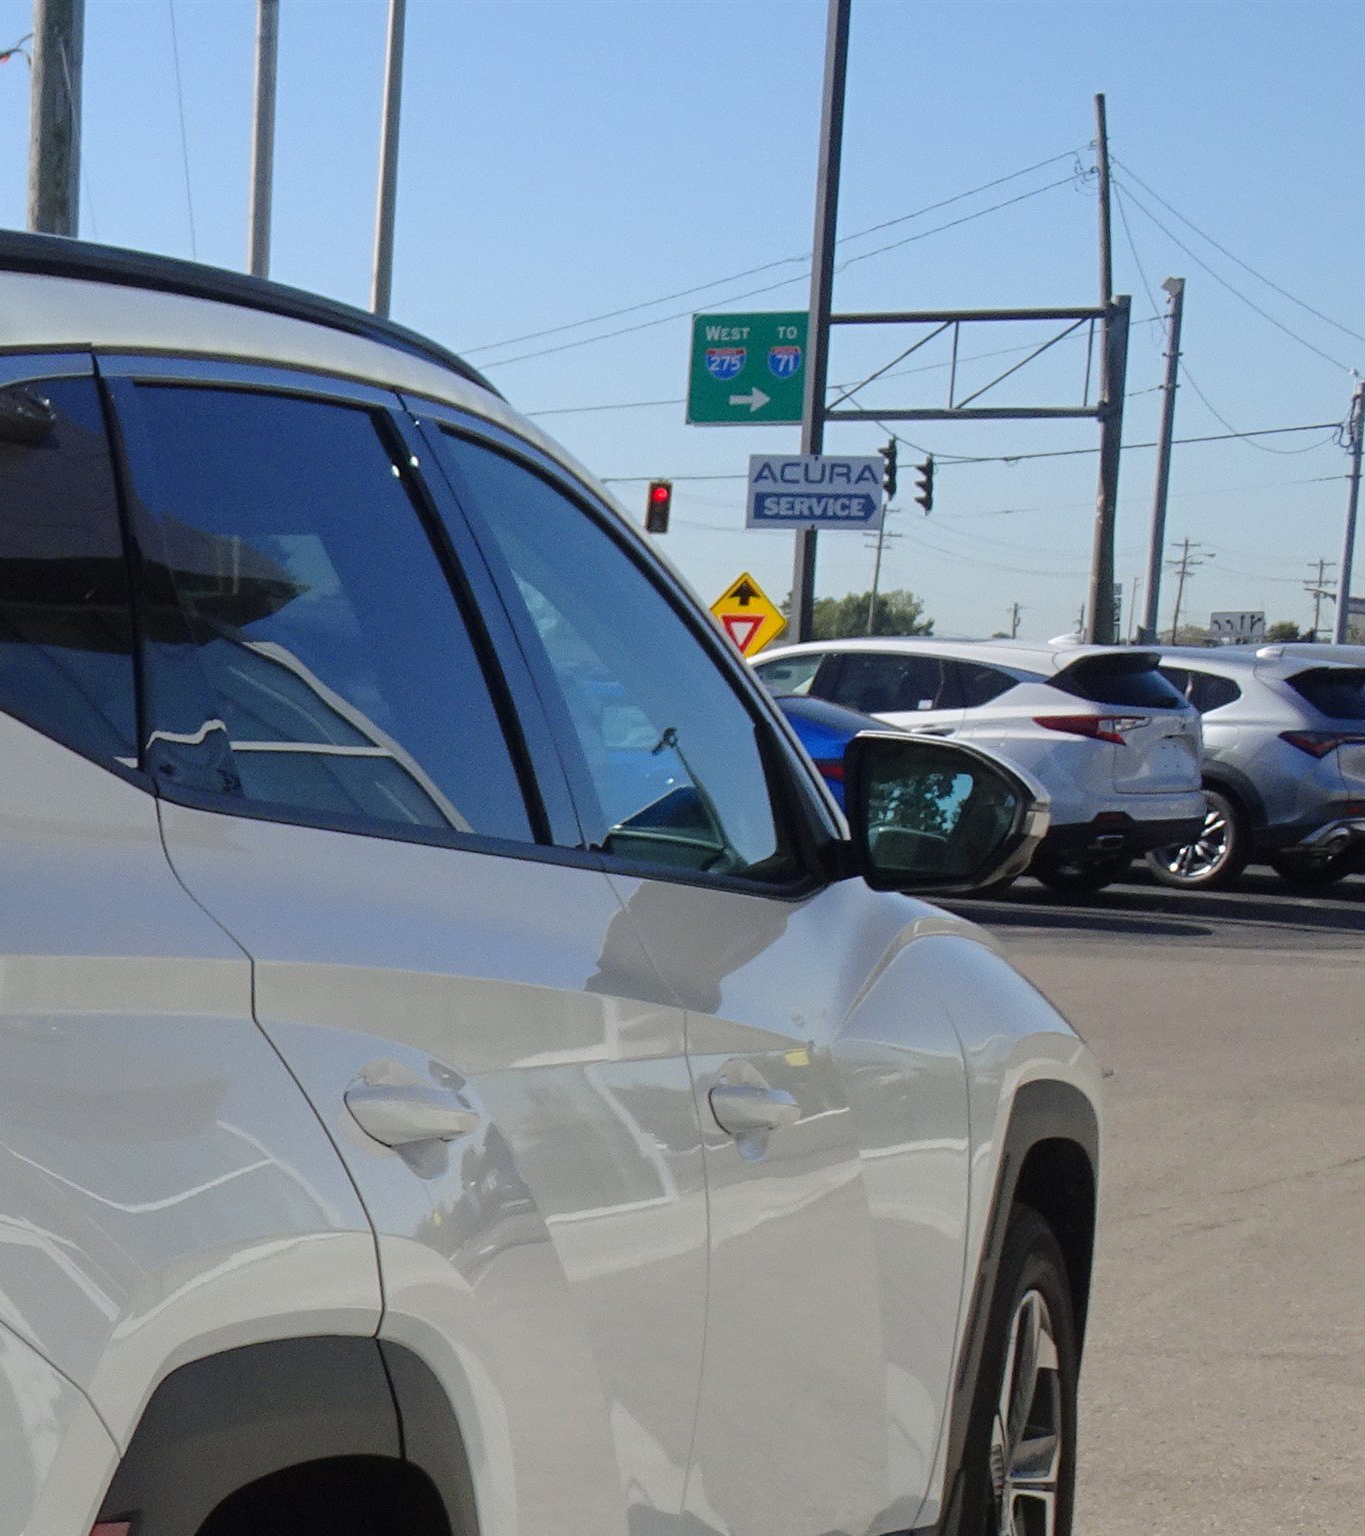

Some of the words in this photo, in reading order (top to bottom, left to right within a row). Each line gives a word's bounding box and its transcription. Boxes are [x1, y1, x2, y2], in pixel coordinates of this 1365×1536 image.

[705, 325, 750, 341] WEST
[777, 325, 798, 339] TO
[710, 355, 741, 371] 275
[775, 354, 795, 372] 71
[752, 461, 880, 486] ACURA
[763, 496, 866, 518] SERVICE
